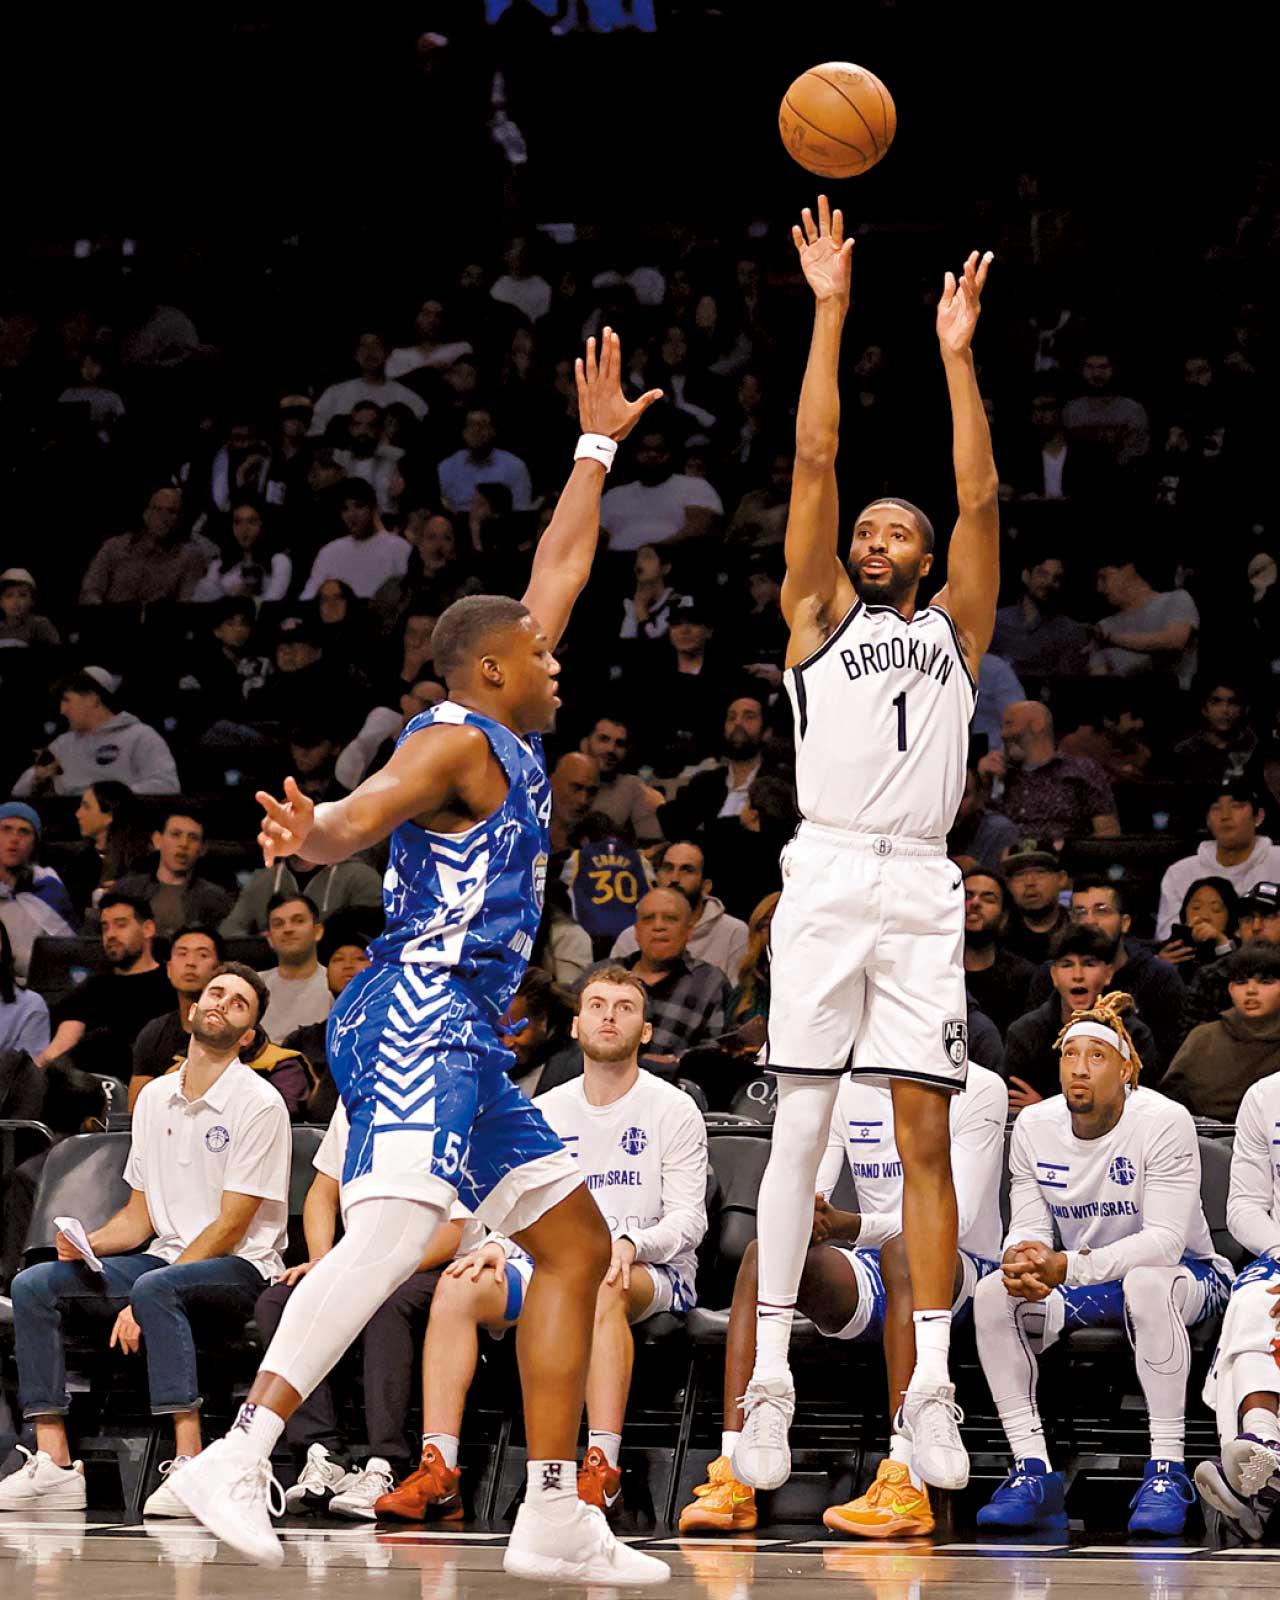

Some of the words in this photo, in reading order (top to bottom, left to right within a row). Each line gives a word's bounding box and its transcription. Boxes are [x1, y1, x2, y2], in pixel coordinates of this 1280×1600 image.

[840, 637, 954, 686] BROOKLYN
[892, 691, 908, 752] 1
[588, 870, 638, 905] 30
[853, 1162, 880, 1178] STAND
[882, 1161, 902, 1178] WIT
[1070, 1201, 1099, 1218] WITH
[1100, 1200, 1140, 1217] ISRAEL
